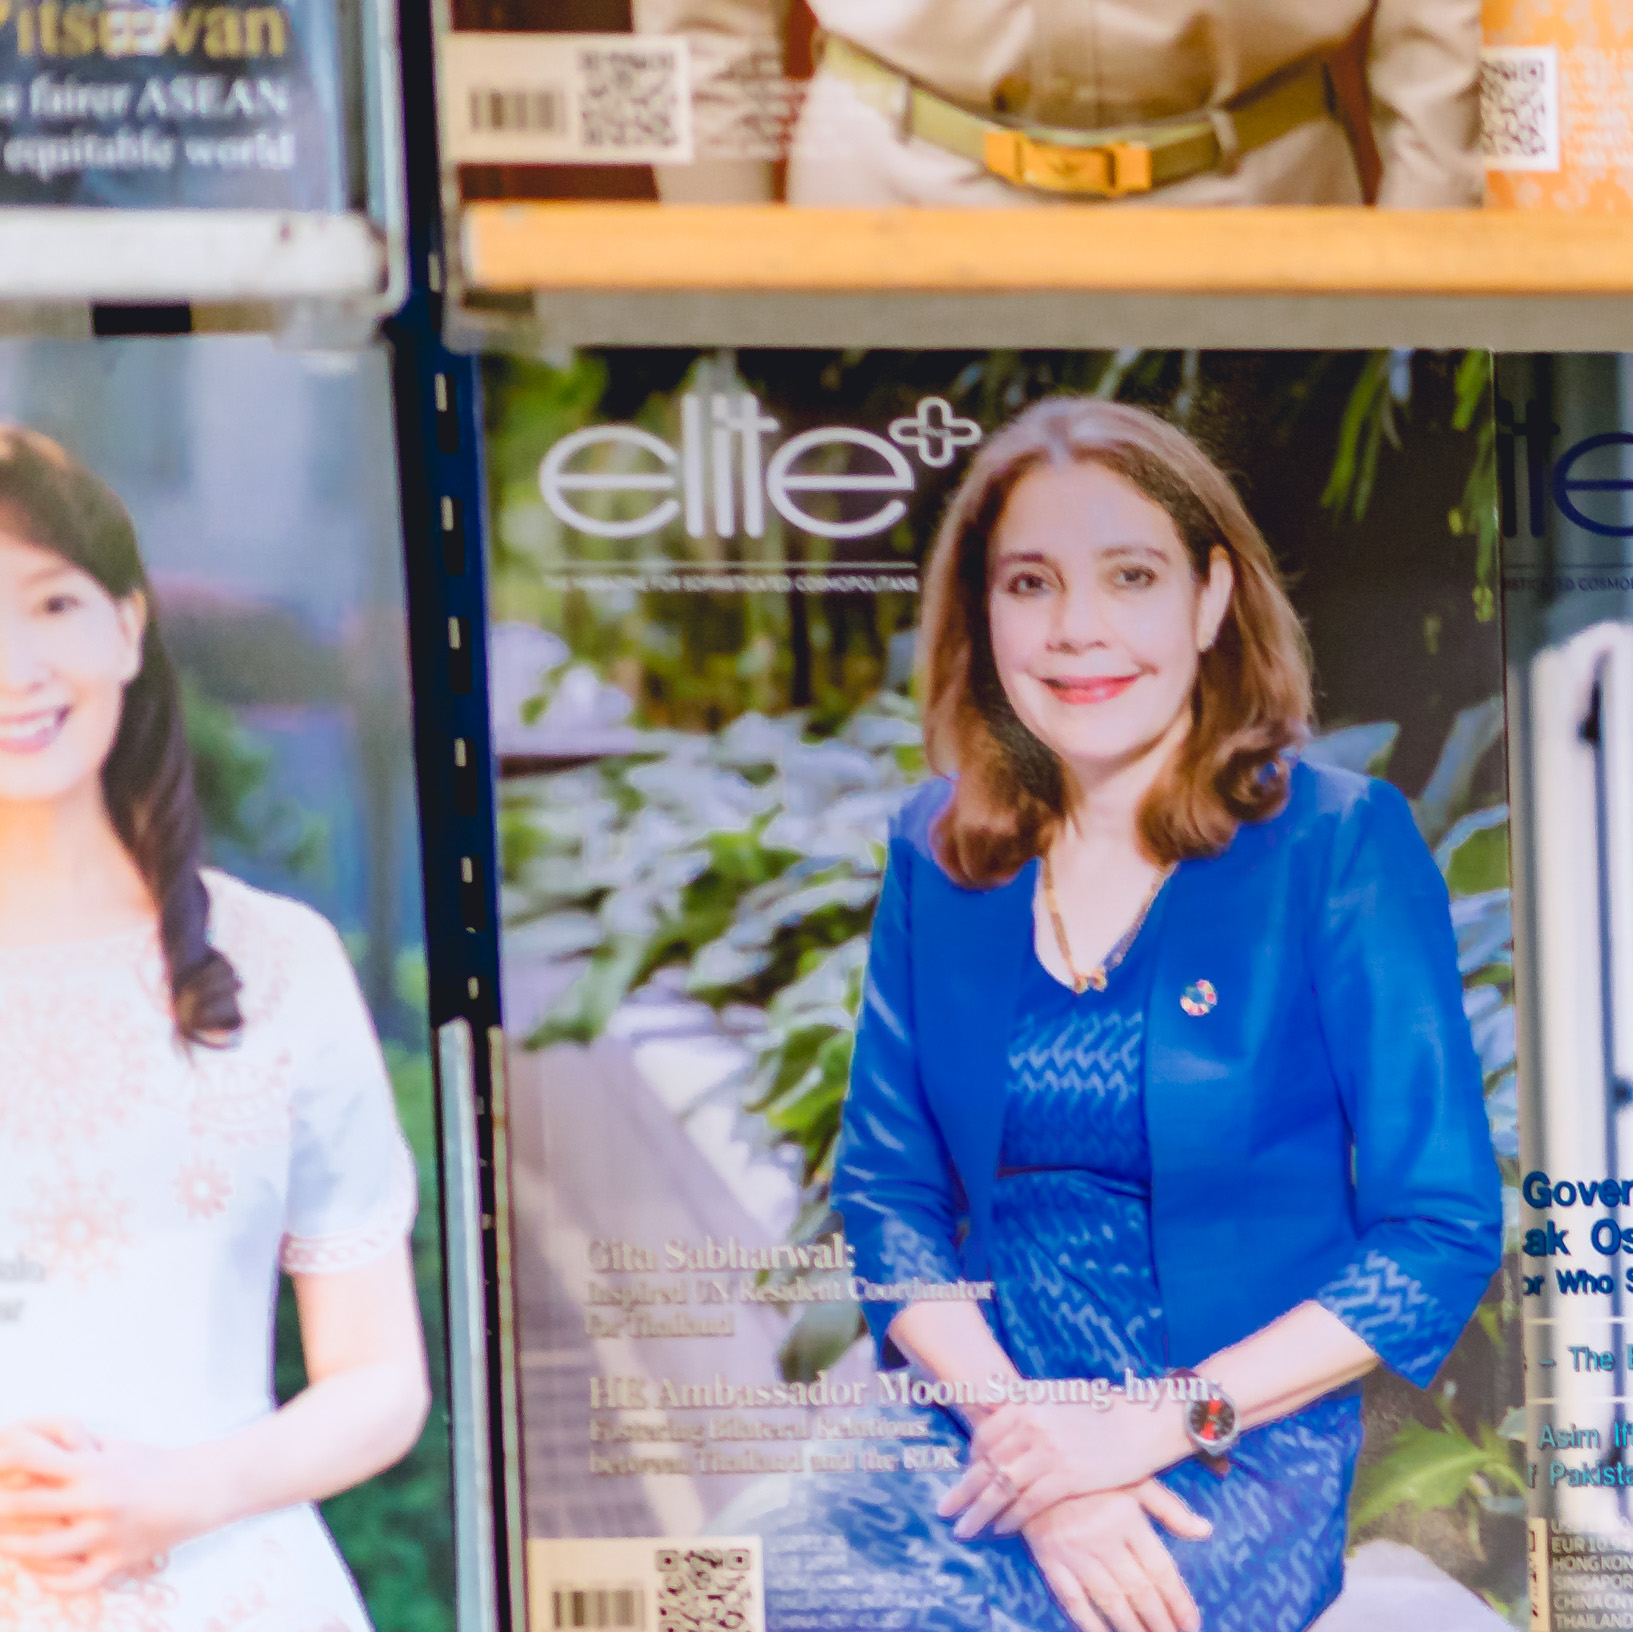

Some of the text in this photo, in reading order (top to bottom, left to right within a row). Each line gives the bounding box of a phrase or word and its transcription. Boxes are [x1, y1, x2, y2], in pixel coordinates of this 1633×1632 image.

[539, 393, 915, 539] elite
[1556, 1270, 1614, 1295] Who
[1569, 1345, 1615, 1371] The
